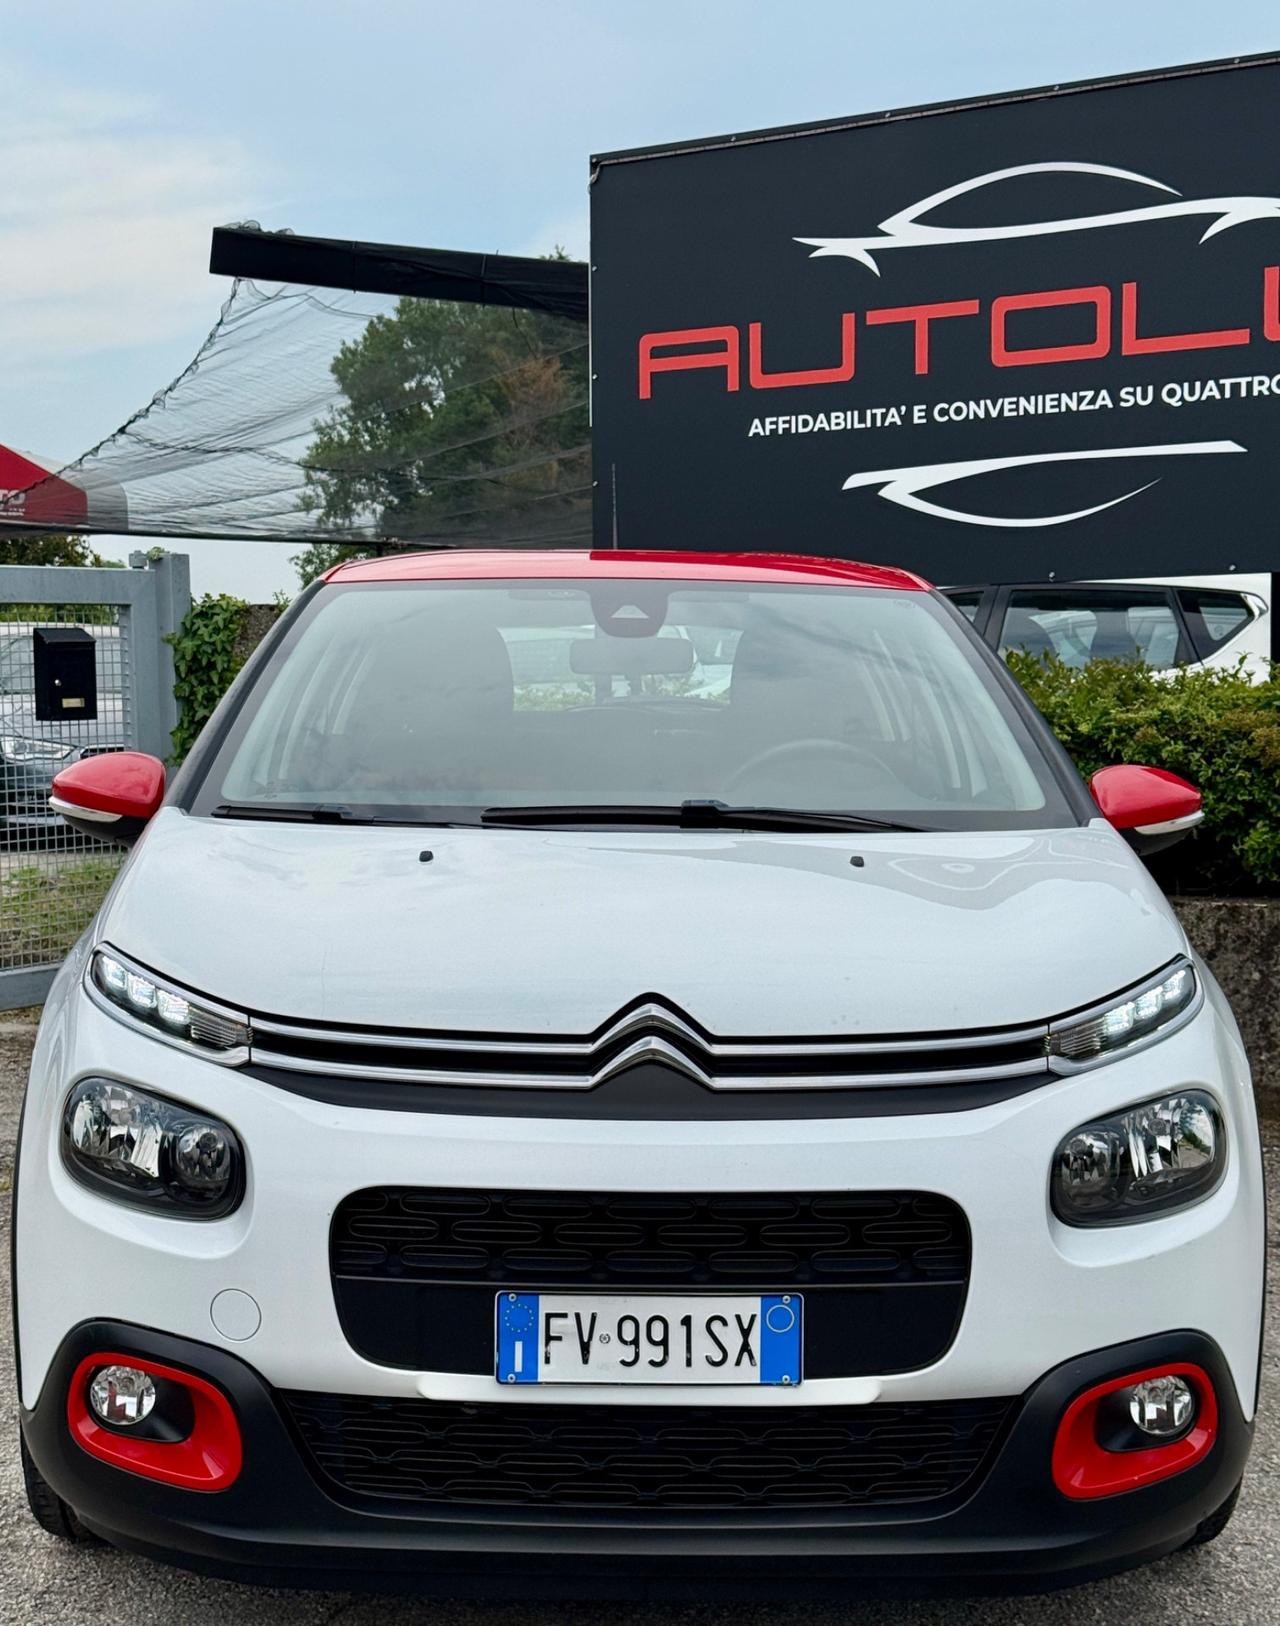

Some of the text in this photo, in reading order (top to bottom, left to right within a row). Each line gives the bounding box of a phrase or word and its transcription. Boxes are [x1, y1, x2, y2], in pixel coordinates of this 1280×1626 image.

[638, 266, 1280, 400] AUTOL
[912, 404, 927, 425] E
[933, 389, 1114, 423] CONVENIENZA
[1119, 385, 1154, 408] SU
